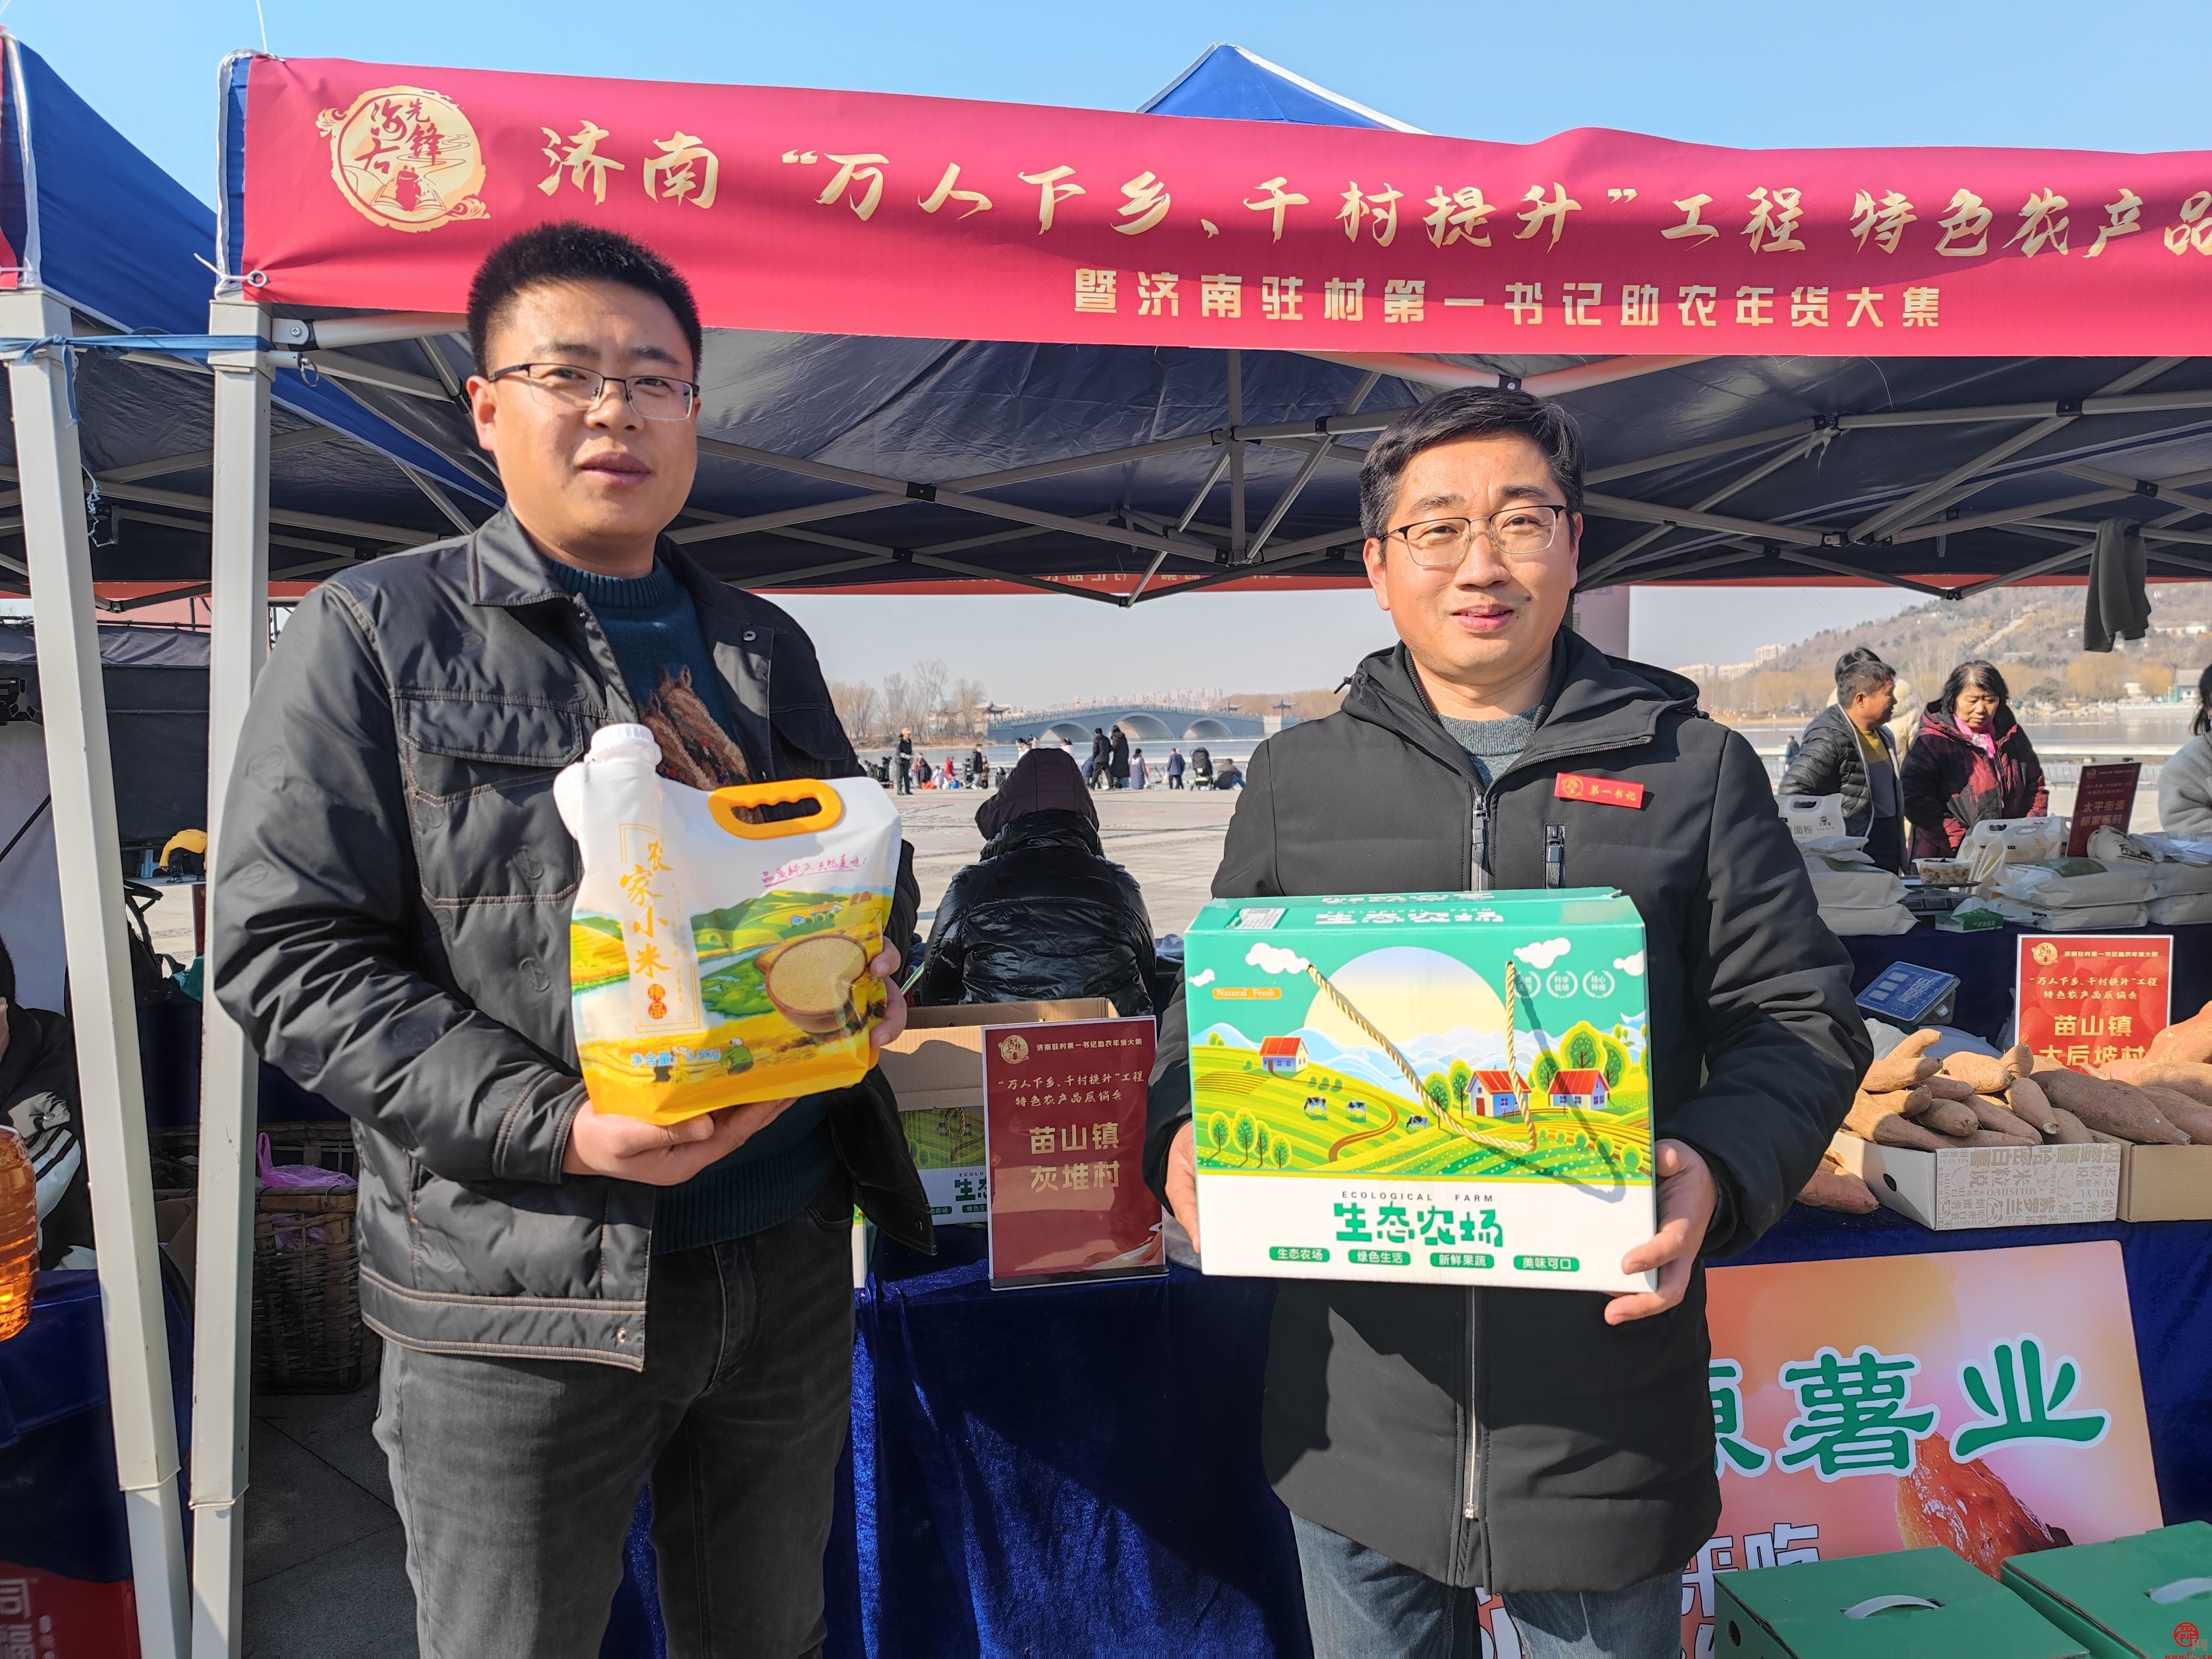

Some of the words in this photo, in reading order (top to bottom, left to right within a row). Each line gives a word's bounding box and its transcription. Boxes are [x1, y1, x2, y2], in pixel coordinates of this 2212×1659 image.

[537, 120, 720, 209] 济南
[1074, 267, 1940, 327] 暨济南驻村第一书记助农年货大集
[1590, 785, 1636, 801] 第一书记
[1789, 825, 1812, 835] 面粉
[620, 839, 674, 979] 农家小米
[648, 984, 667, 1019] 精品
[1216, 988, 1247, 996] Natural
[1253, 988, 1275, 996] Fresh
[2054, 1015, 2133, 1037] 苗山镇
[1036, 1038, 1143, 1052] 济南驻村第一书记助农年货大集
[1015, 1089, 1123, 1108] 特色农产品展销会
[1030, 1121, 1119, 1155] 苗山镇
[1030, 1160, 1120, 1193] 灰堆村
[1342, 1191, 1432, 1200] ECOLOGICAL
[1333, 1200, 1503, 1248] 生态农场
[1277, 1248, 1323, 1261] 生态农场
[1356, 1250, 1404, 1264] 绿色生活
[1438, 1254, 1487, 1267] 新鲜果蔬
[1522, 1256, 1572, 1269] 美味可口
